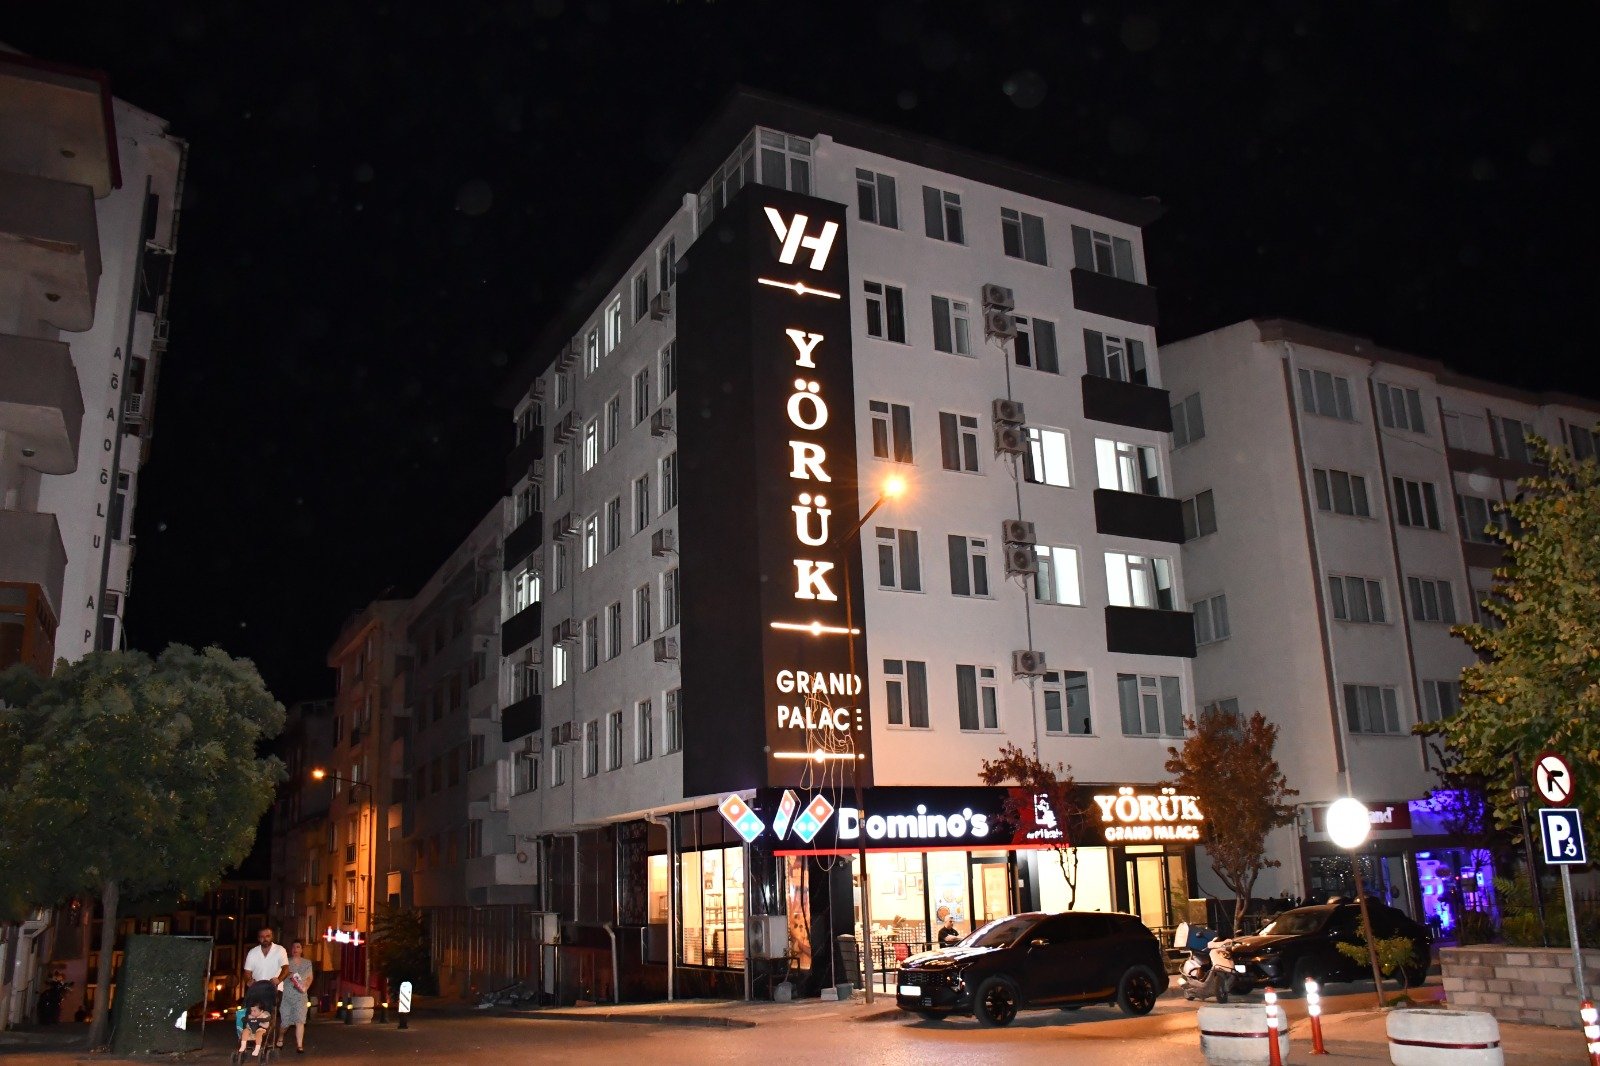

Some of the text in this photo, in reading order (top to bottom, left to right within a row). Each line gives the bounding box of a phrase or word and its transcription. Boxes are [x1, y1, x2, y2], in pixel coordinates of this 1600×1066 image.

[763, 206, 839, 271] YH
[785, 328, 838, 602] YÖRÜK
[84, 346, 122, 643] AĞAOĞLU AP
[776, 669, 862, 696] GRAND
[837, 804, 989, 839] Domino's
[1093, 786, 1204, 822] YÖRÜK
[1104, 826, 1152, 842] GRAND
